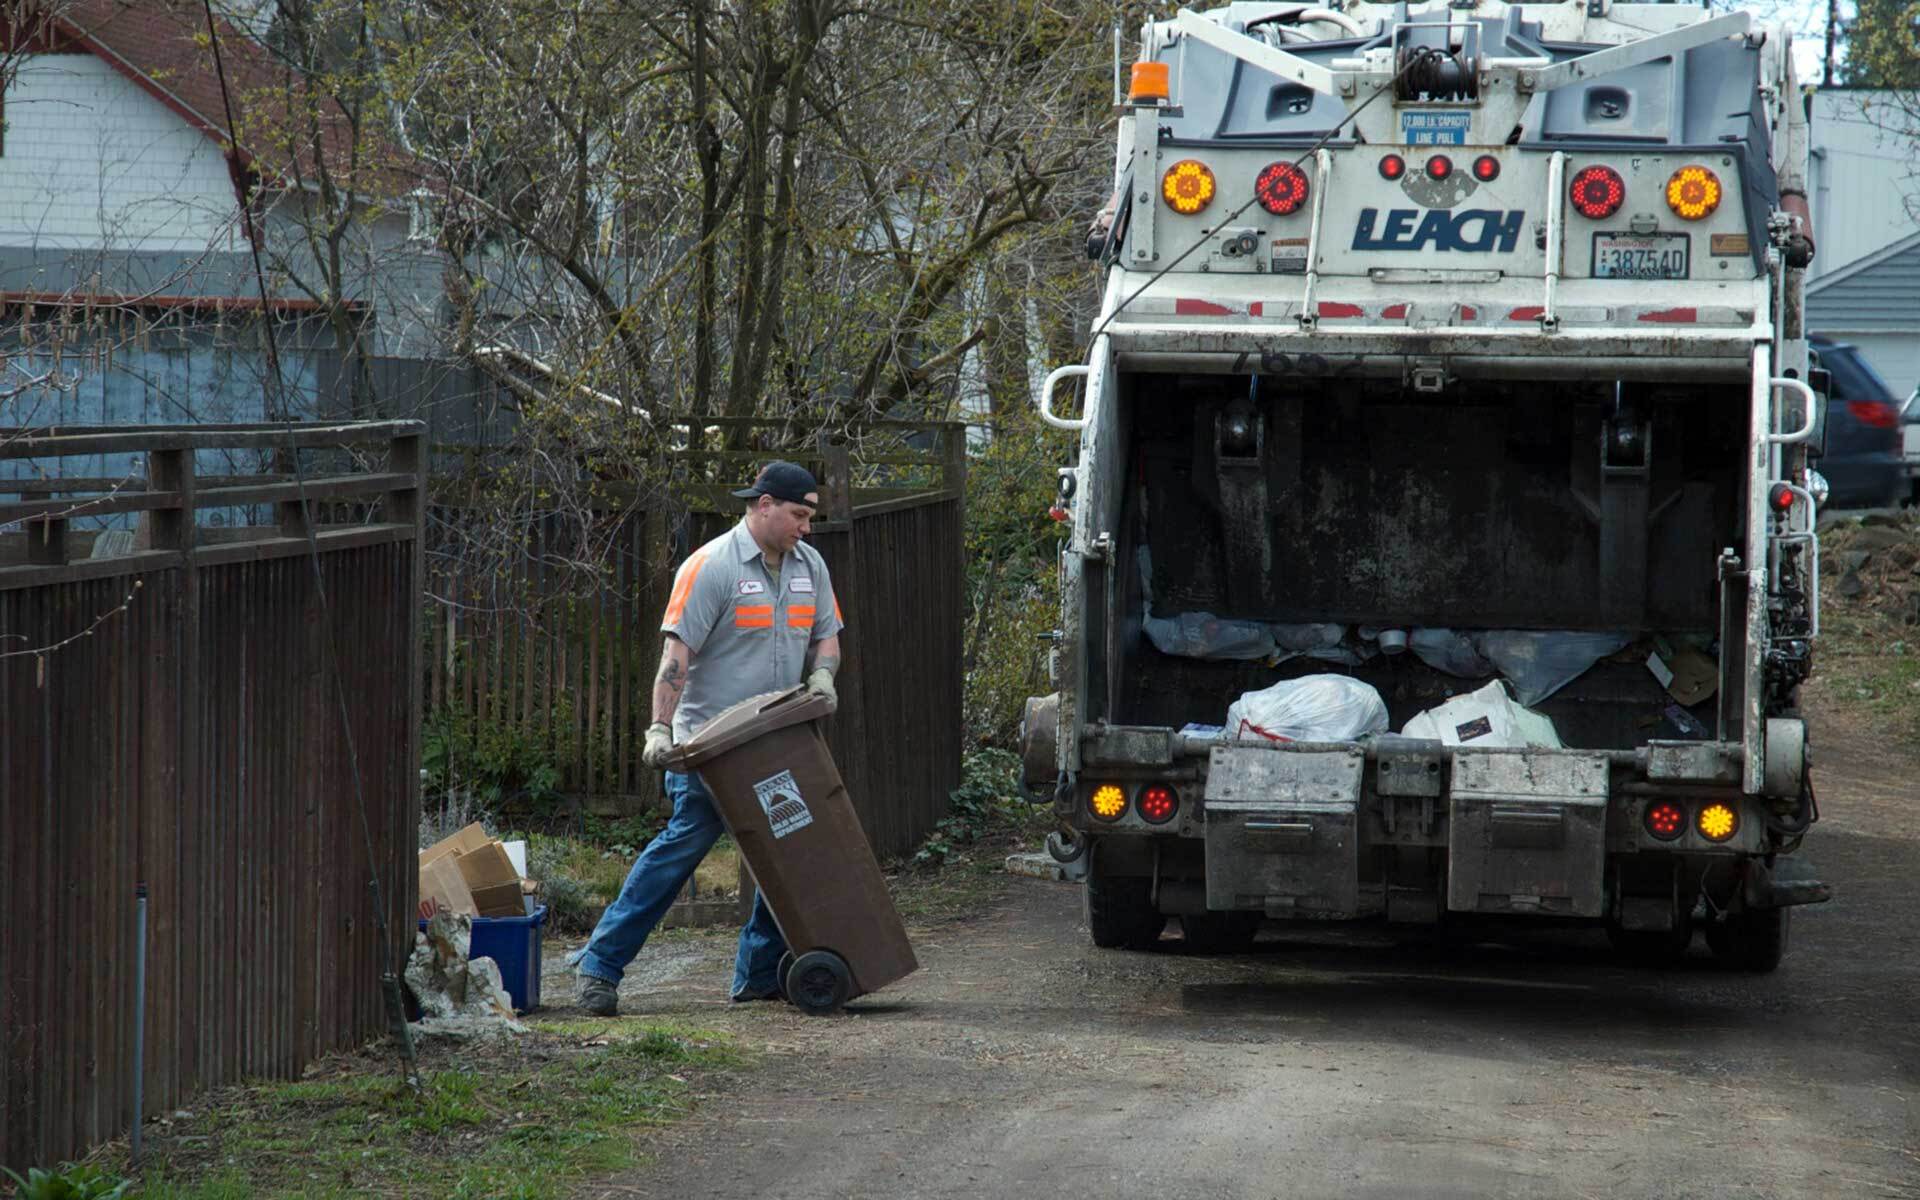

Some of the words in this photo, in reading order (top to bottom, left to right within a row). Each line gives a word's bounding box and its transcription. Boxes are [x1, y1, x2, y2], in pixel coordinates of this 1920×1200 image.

[1416, 131, 1433, 145] LINE
[1436, 131, 1456, 145] PULL
[1351, 208, 1525, 252] LEACH
[1601, 239, 1654, 249] WASHINGTON
